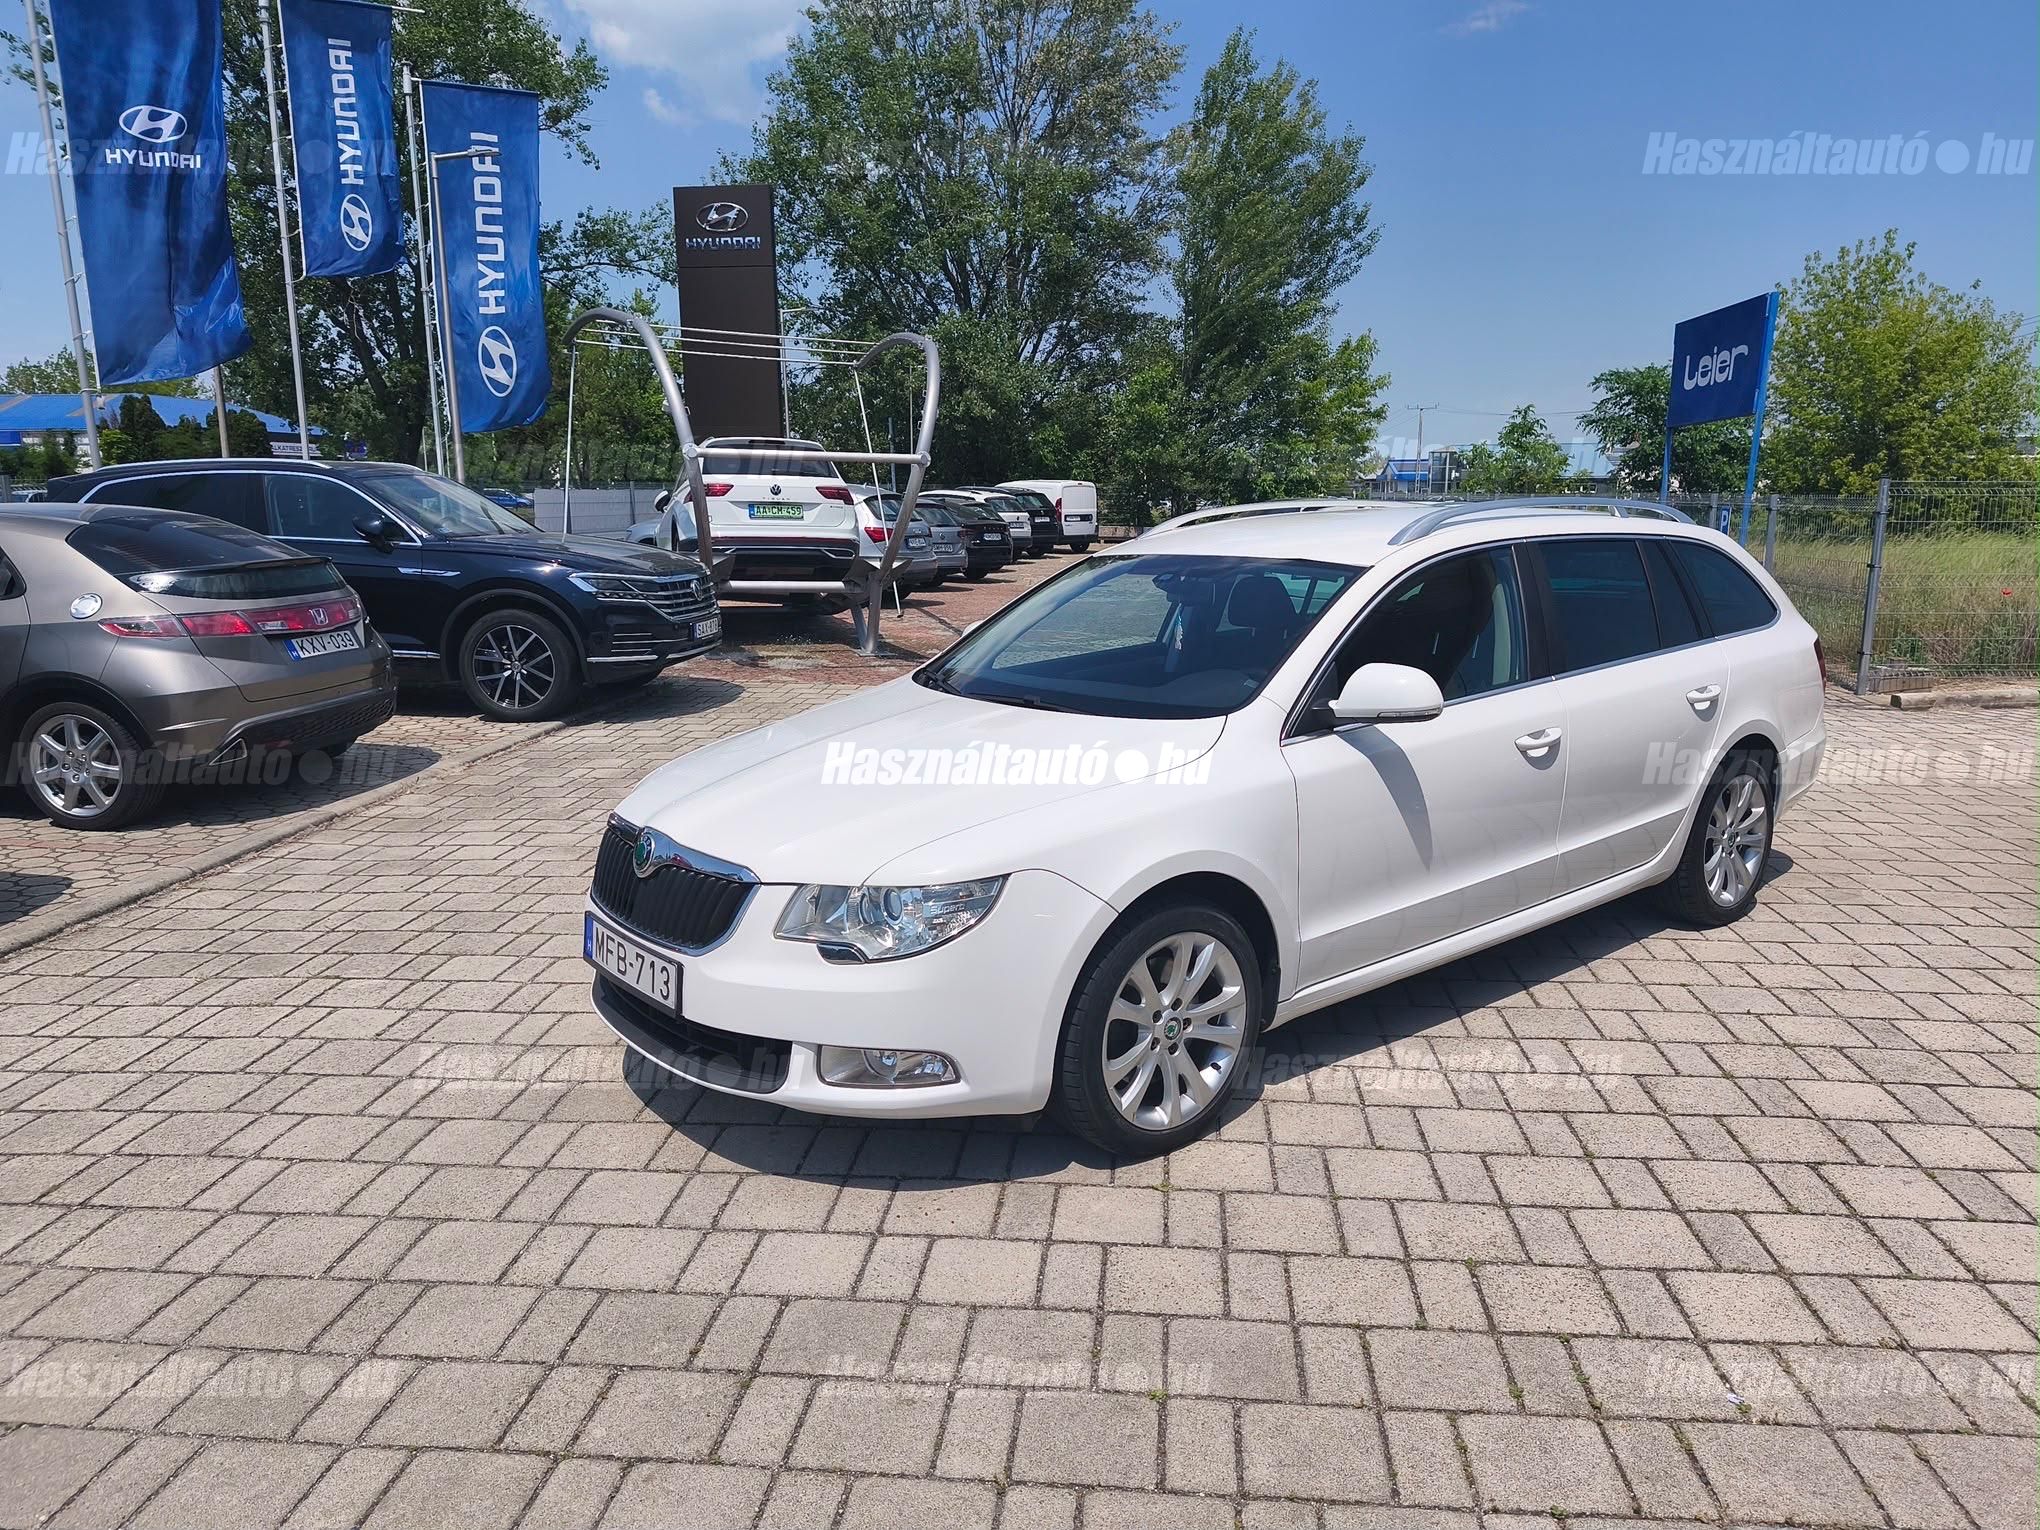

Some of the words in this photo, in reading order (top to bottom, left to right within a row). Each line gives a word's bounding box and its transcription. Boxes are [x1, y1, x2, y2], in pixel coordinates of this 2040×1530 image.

[328, 38, 364, 185] HYUNDAI
[105, 148, 201, 168] HYUNDAI
[470, 132, 506, 315] HYUNDAI
[685, 236, 761, 250] HYUNDAI
[1683, 344, 1749, 390] Leier
[1721, 510, 1729, 532] P
[295, 632, 356, 656] KXV-039
[595, 926, 670, 1001] MFB-713
